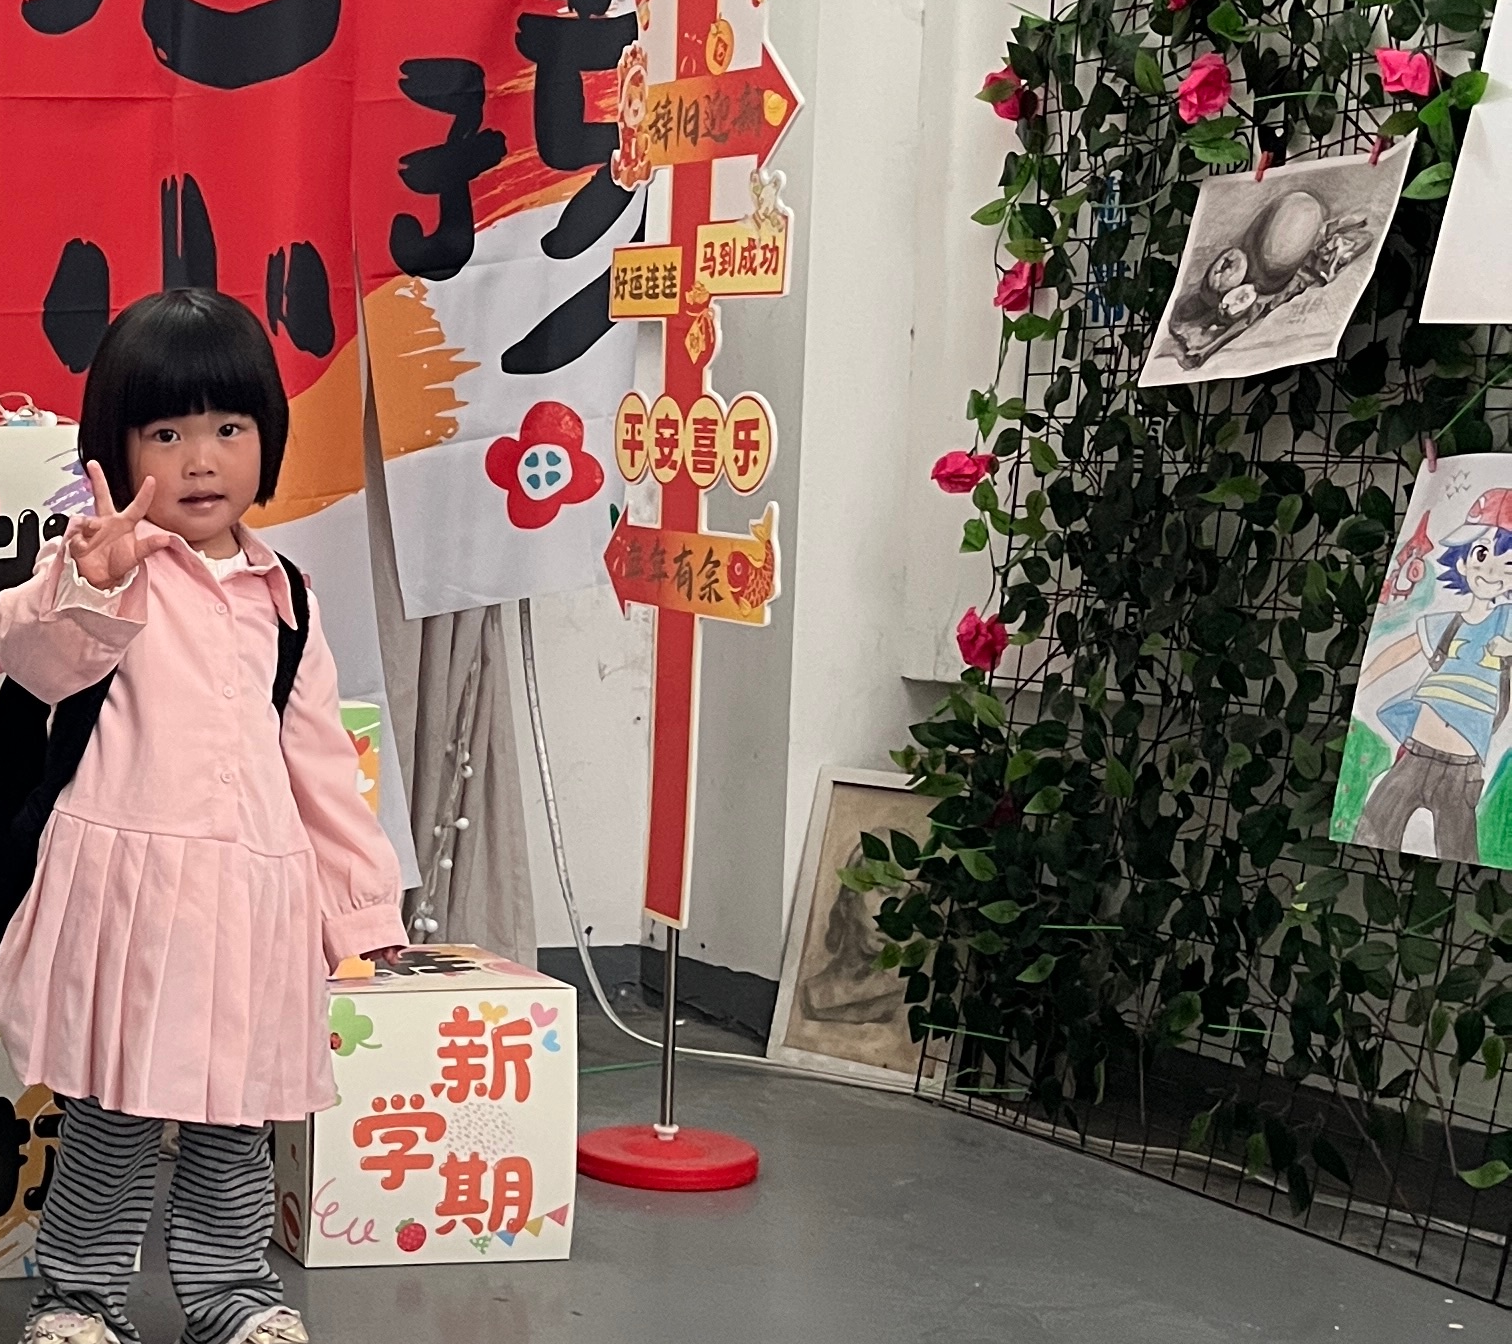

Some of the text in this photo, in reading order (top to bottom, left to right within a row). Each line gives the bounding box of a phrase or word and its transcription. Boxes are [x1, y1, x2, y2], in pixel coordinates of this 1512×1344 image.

[647, 81, 763, 153] 辞旧迎新
[612, 258, 680, 302] 好运连连
[698, 239, 780, 280] 马到成功
[621, 412, 762, 477] 平安喜乐
[353, 1005, 534, 1237] 新学期
